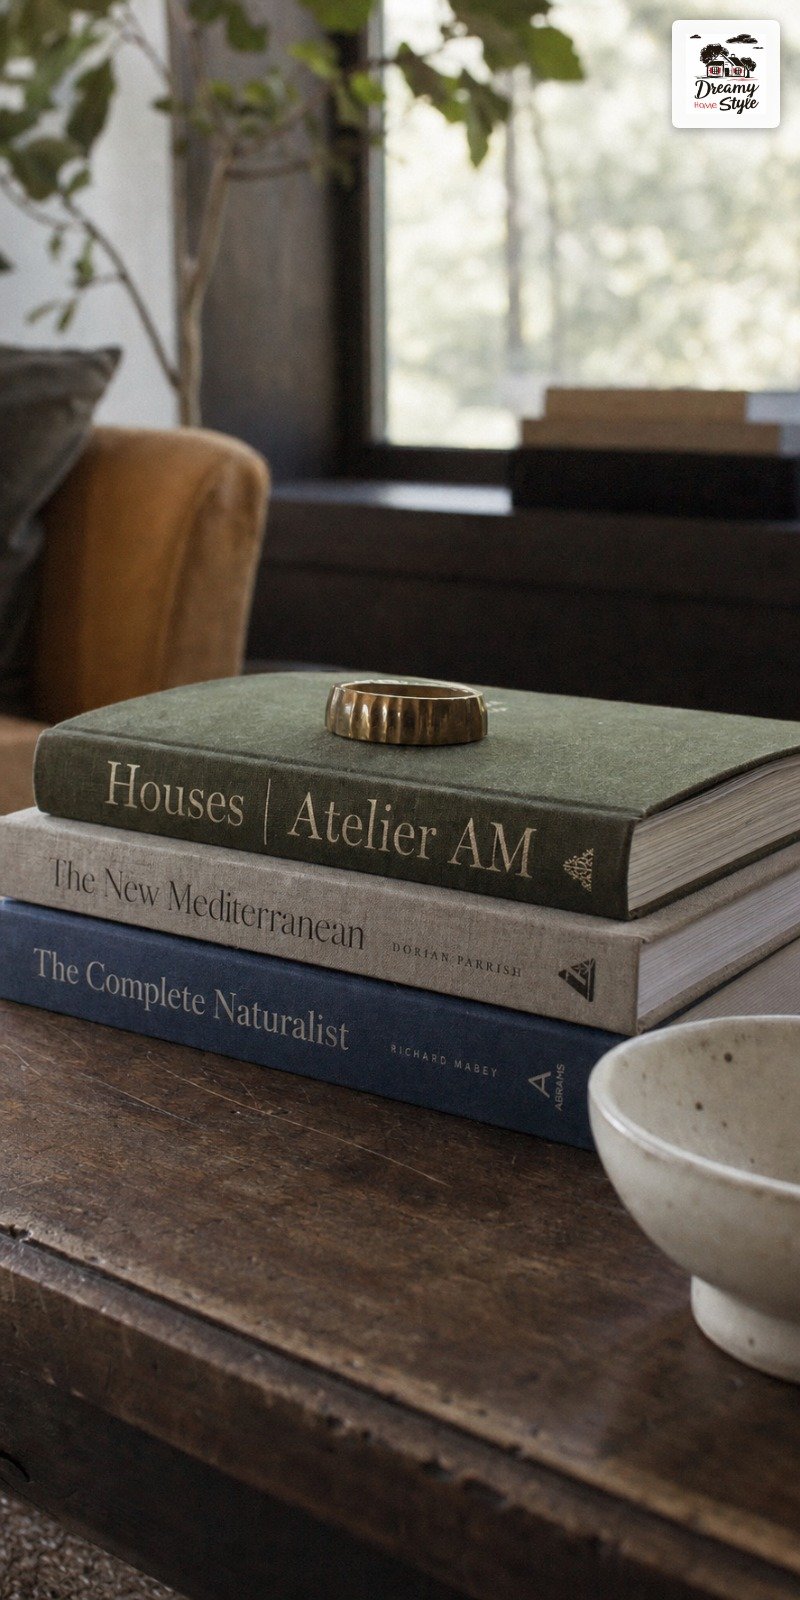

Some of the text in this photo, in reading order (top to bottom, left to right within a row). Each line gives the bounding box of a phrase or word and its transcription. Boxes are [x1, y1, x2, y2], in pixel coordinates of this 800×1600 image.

[105, 760, 537, 879] Houses Atelier AM
[50, 857, 364, 950] The New Mediterranean
[391, 941, 522, 978] DORIAN PARRISH
[33, 948, 350, 1051] The Complete Naturalist
[390, 1044, 498, 1078] RICHARD MABEY
[554, 1063, 566, 1112] ABRAMS
